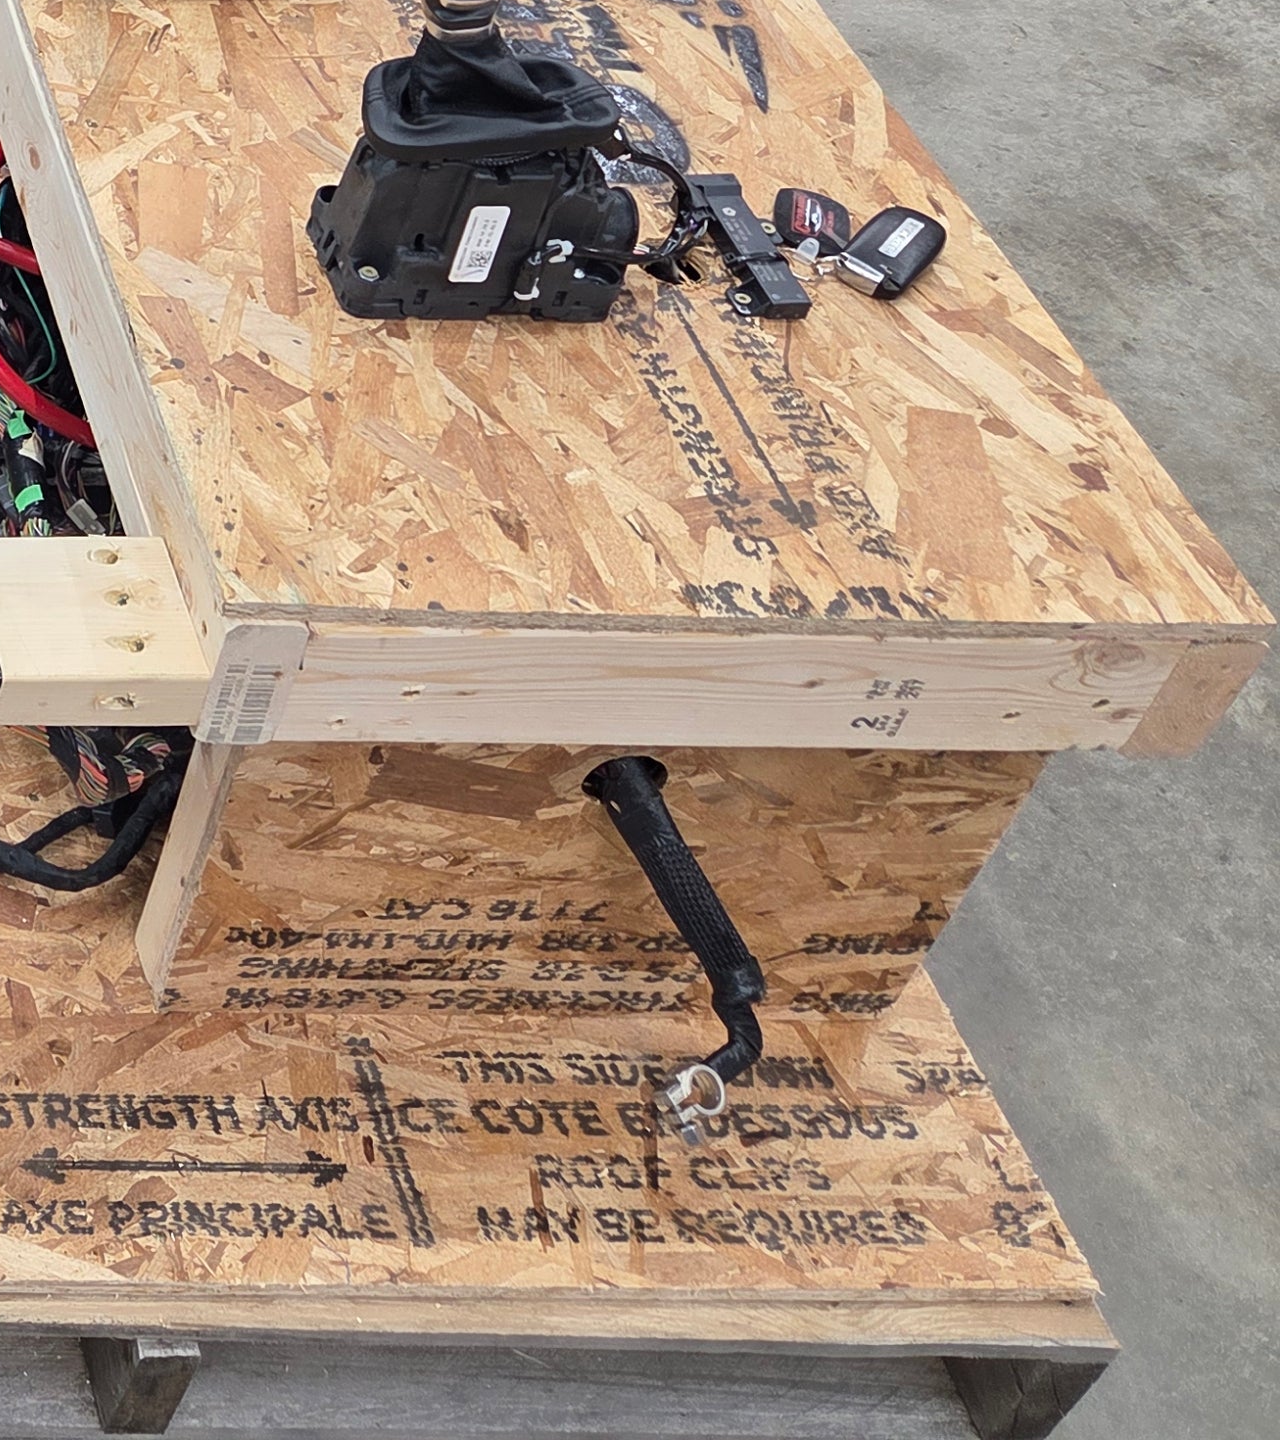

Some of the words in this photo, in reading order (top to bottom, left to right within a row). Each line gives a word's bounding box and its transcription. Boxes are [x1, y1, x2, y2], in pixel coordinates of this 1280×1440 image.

[373, 897, 469, 921] CAT
[438, 1050, 553, 1086] THIS
[254, 1095, 358, 1134] AXIS
[471, 1098, 608, 1138] COTE
[702, 1103, 921, 1141] DESSOUS
[536, 1152, 672, 1190] ROOF
[689, 1153, 833, 1192] CLIPS
[0, 1198, 95, 1236] AXE
[107, 1199, 399, 1241] PRINCIPALE
[476, 1206, 580, 1242] MAY
[593, 1206, 667, 1244] BE
[676, 1207, 928, 1251] REQUIRED
